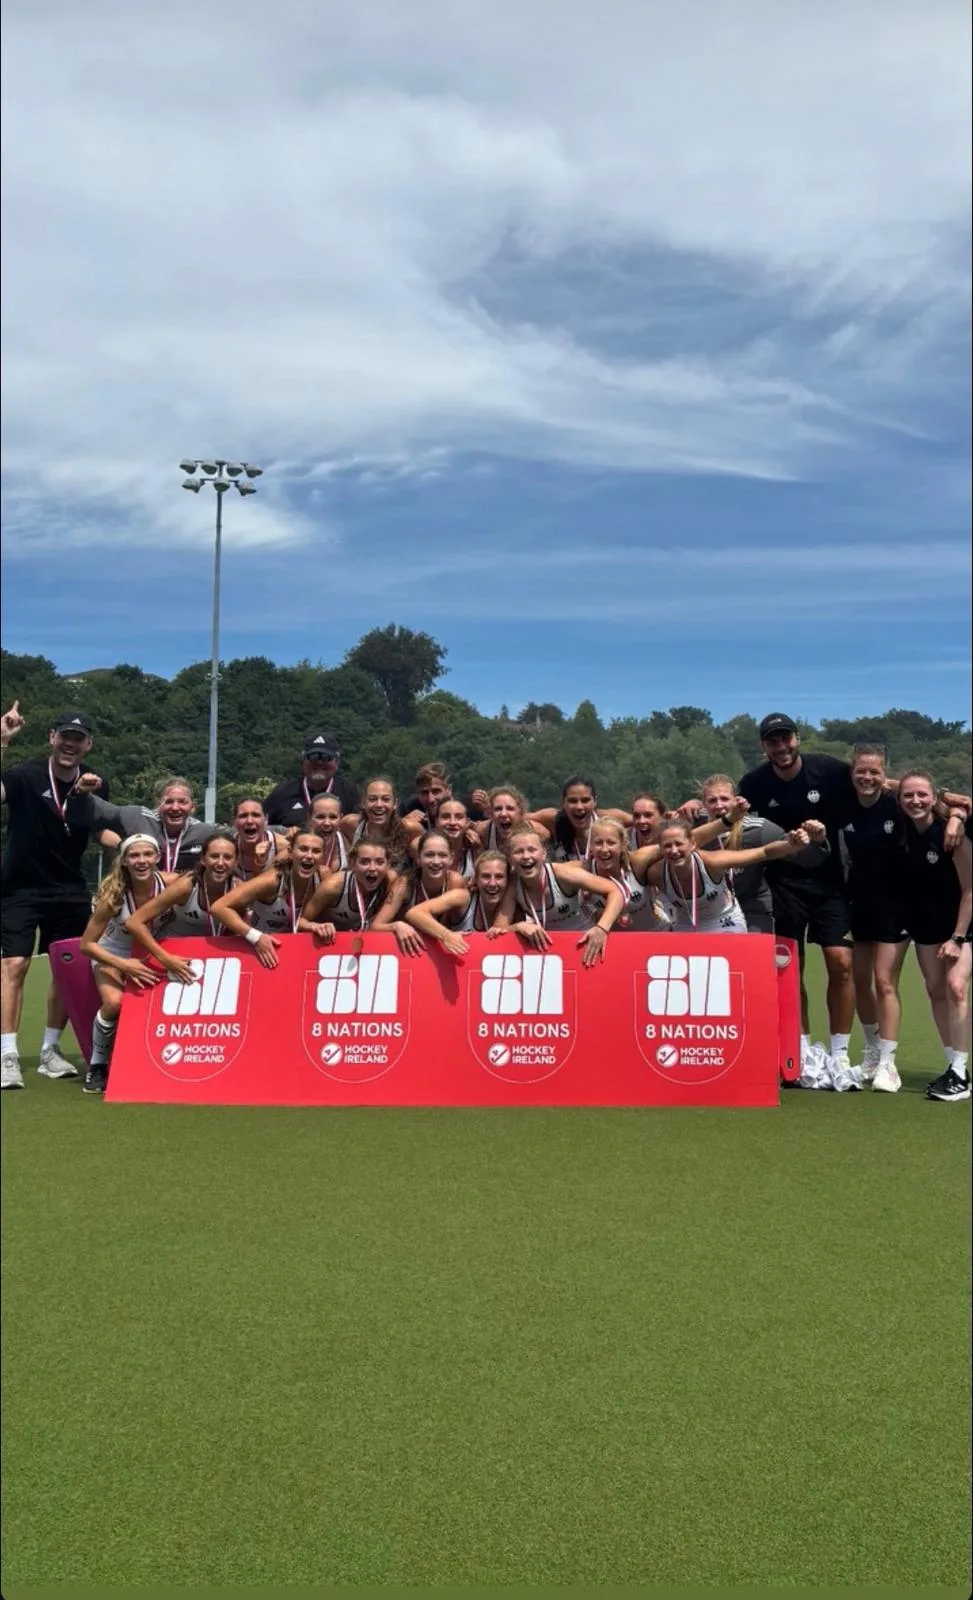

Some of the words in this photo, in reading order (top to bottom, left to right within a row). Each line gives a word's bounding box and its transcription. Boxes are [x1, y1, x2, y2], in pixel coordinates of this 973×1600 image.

[156, 1024, 166, 1038] 8
[170, 1023, 241, 1038] NATIONS
[312, 1023, 322, 1037] 8
[327, 1023, 403, 1037] NATIONS
[479, 1023, 489, 1038] 8
[494, 1023, 570, 1038] NATIONS
[646, 1024, 657, 1039] 8
[661, 1024, 739, 1039] NATIONS
[185, 1045, 226, 1054] HOCKEY
[344, 1045, 388, 1054] HOCKEY
[512, 1046, 556, 1055] HOCKEY
[680, 1047, 724, 1056] HOCKEY
[183, 1054, 225, 1063] IRELAND
[344, 1054, 388, 1064] IRELAND
[512, 1055, 556, 1065] IRELAND
[680, 1056, 724, 1066] IRELAND
